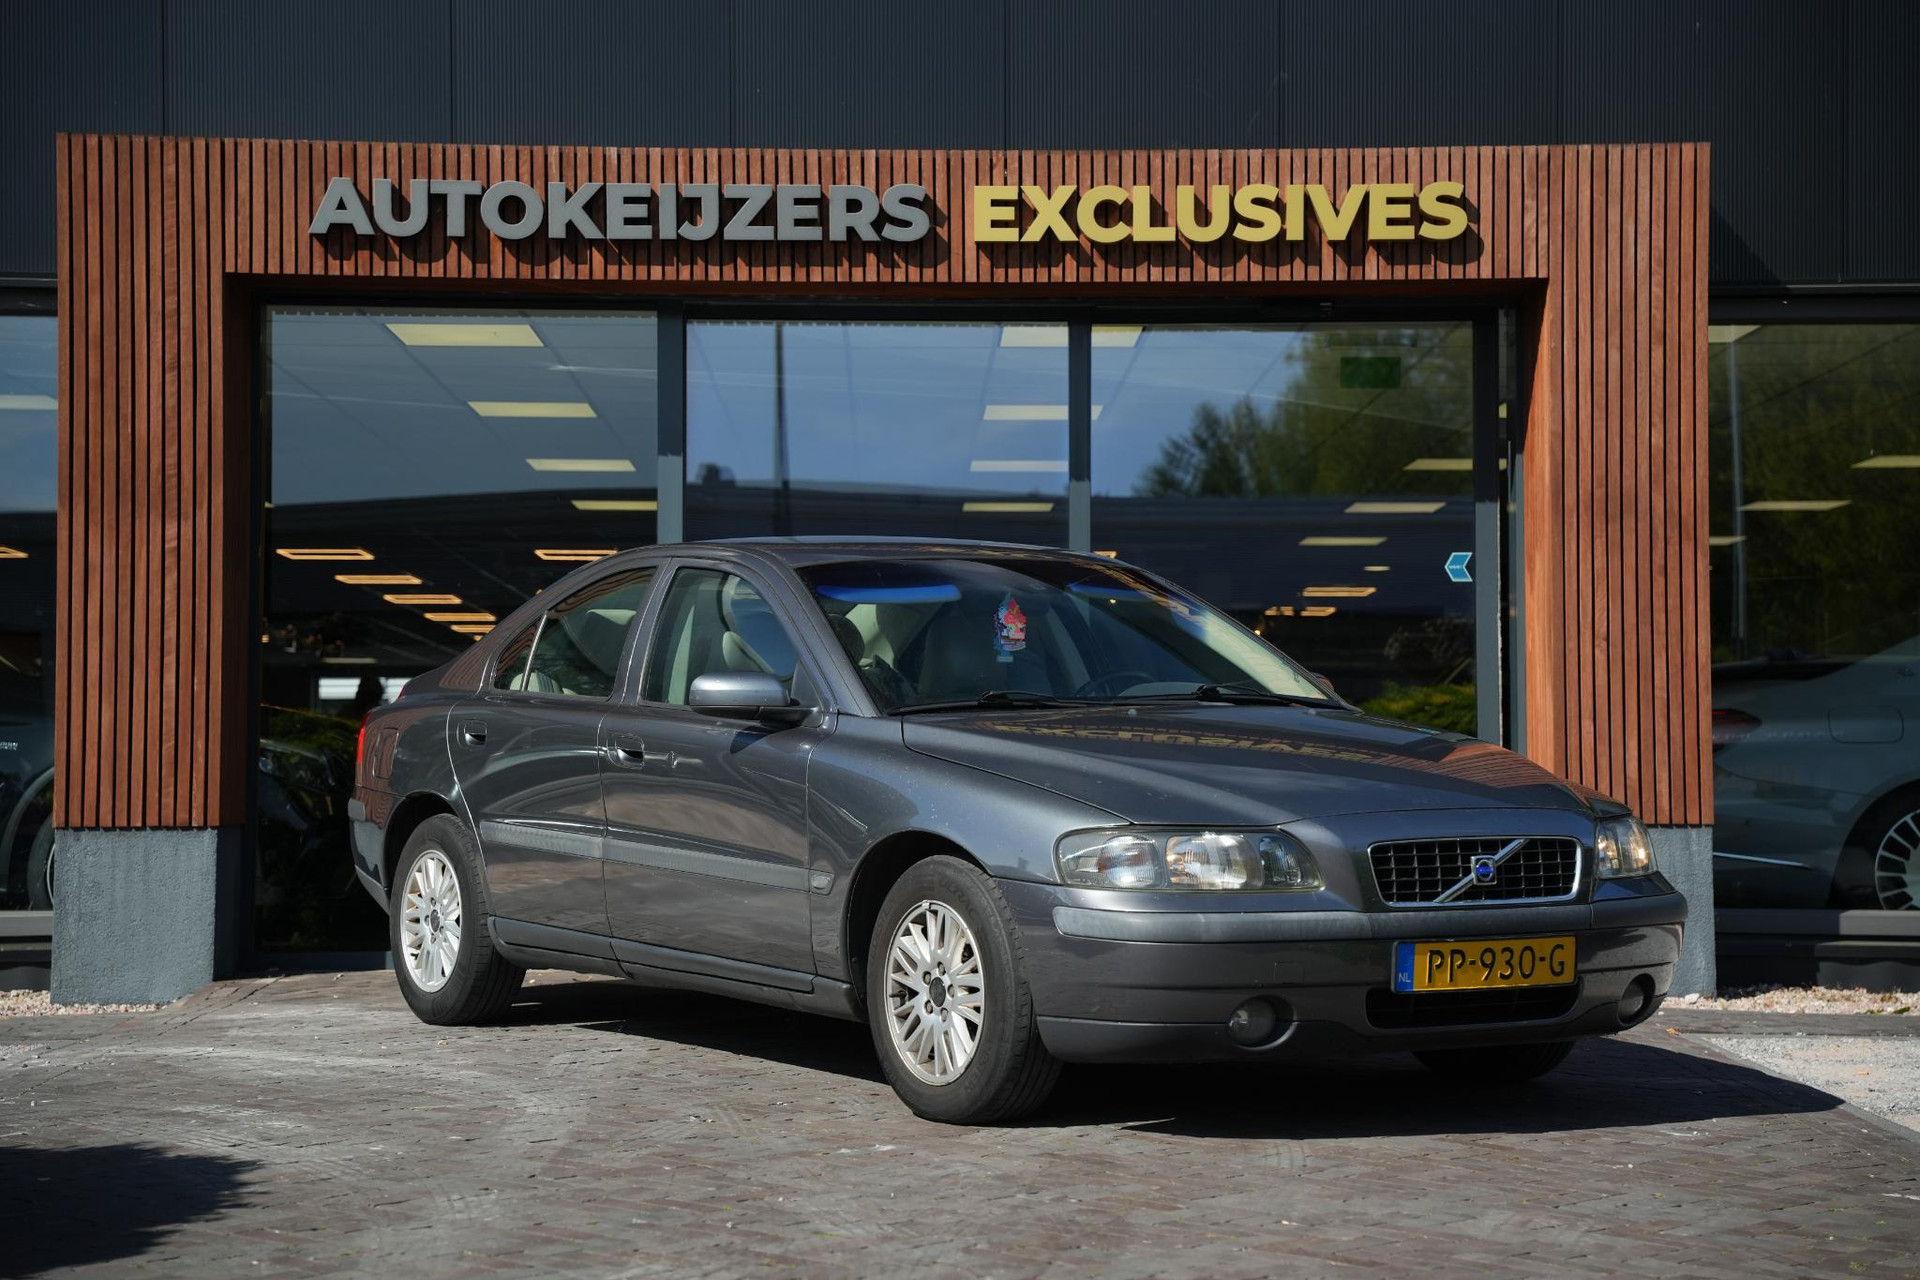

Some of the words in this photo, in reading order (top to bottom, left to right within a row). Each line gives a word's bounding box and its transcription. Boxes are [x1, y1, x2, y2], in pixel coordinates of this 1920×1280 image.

[308, 177, 931, 242] AUTOKEIJZERS
[974, 181, 1468, 243] EXCLUSIVES
[1398, 972, 1411, 983] NL
[1426, 943, 1565, 985] PP-930-G
